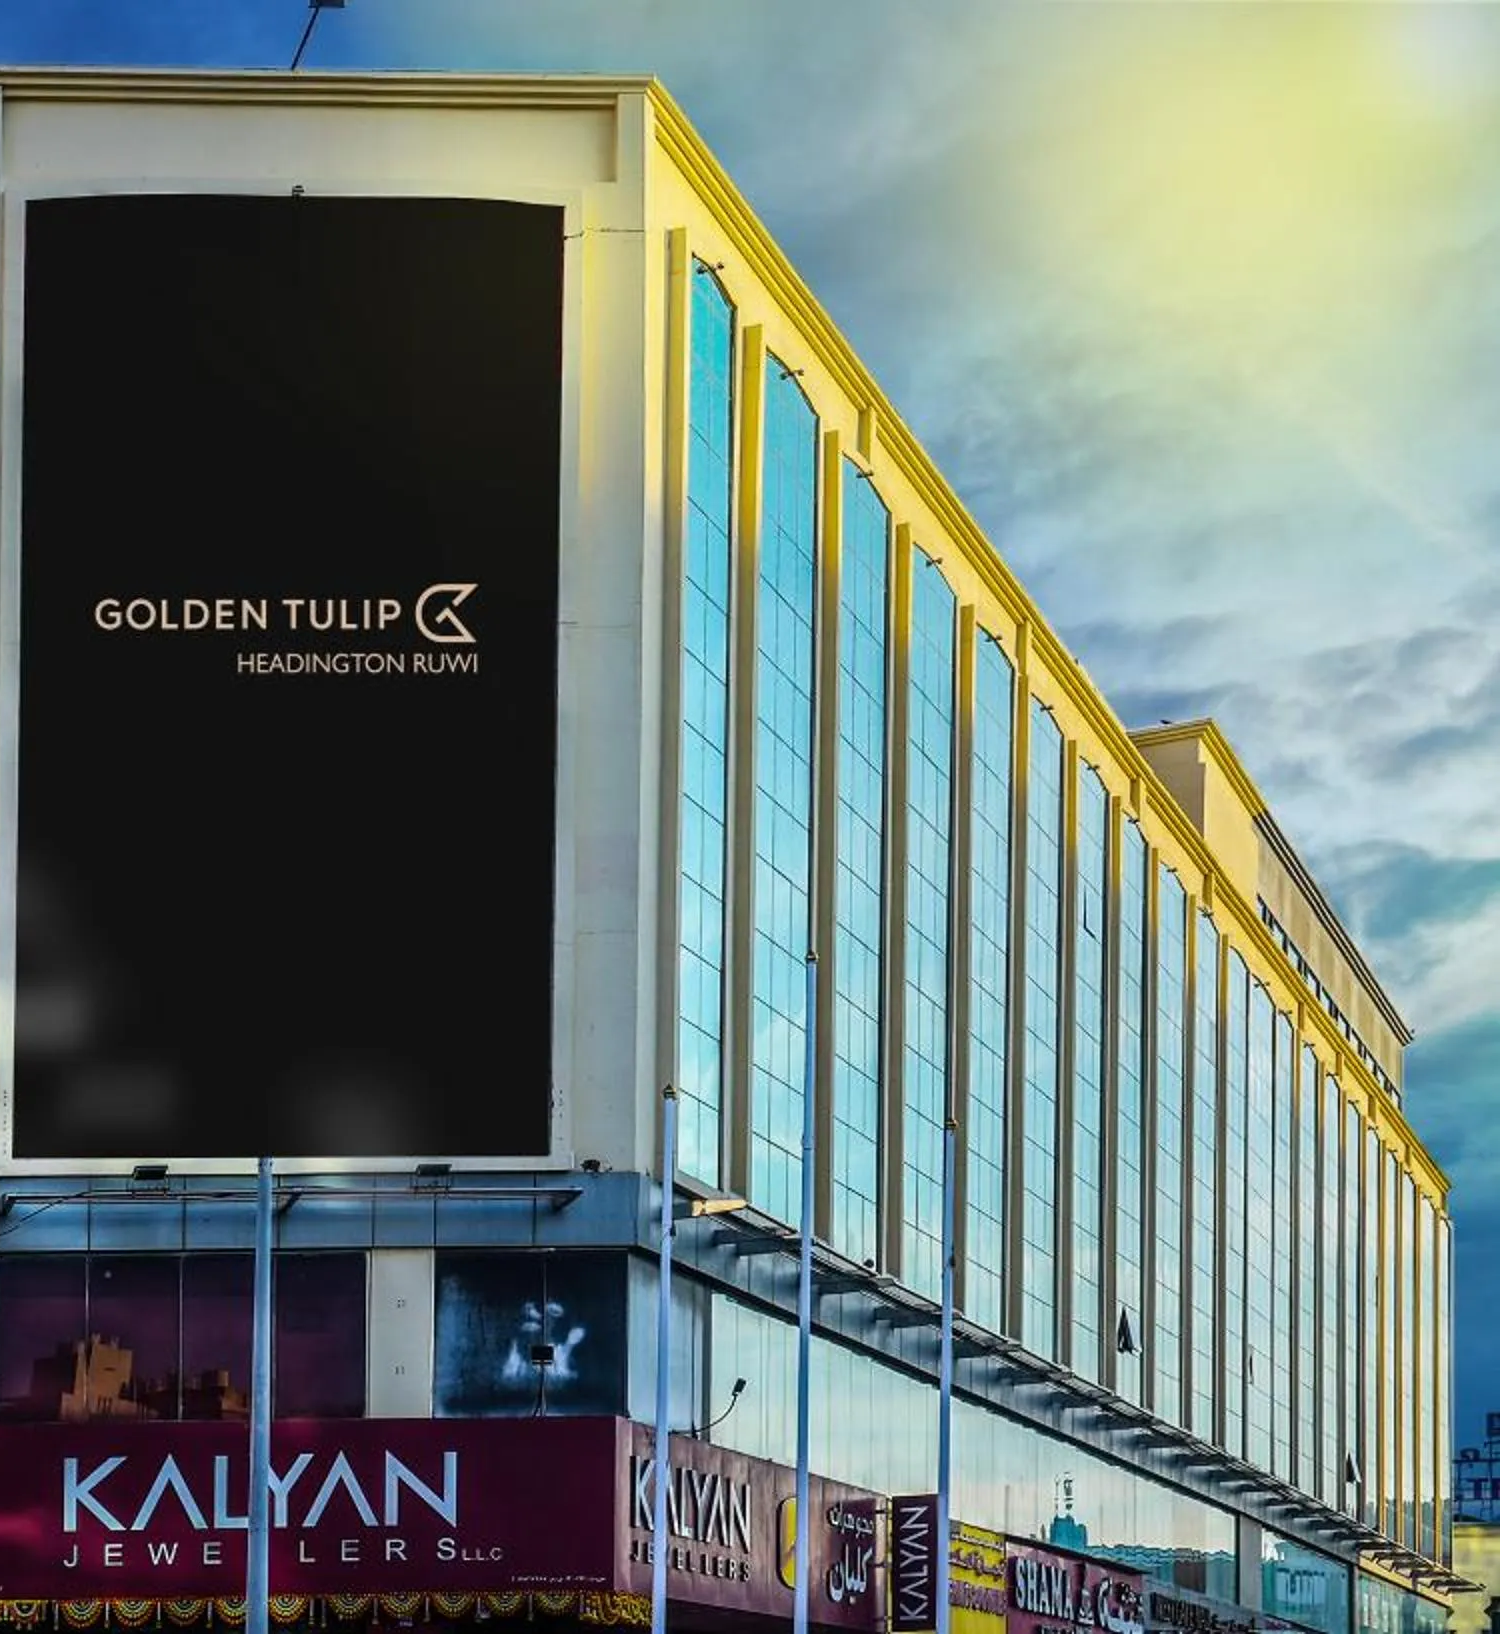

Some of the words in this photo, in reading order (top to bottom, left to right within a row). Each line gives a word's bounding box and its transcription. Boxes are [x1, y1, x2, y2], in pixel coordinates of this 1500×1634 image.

[95, 598, 268, 630] GOLDEN
[282, 598, 401, 630] TULIP
[237, 653, 405, 673] HEADINGTON
[414, 653, 478, 673] RUWI
[63, 1450, 457, 1532] KALYAN
[63, 1537, 456, 1568] JEWELERS
[631, 1540, 751, 1582] JEELLERS
[901, 1505, 928, 1621] KALYAN
[1016, 1557, 1075, 1620] SHAMA
